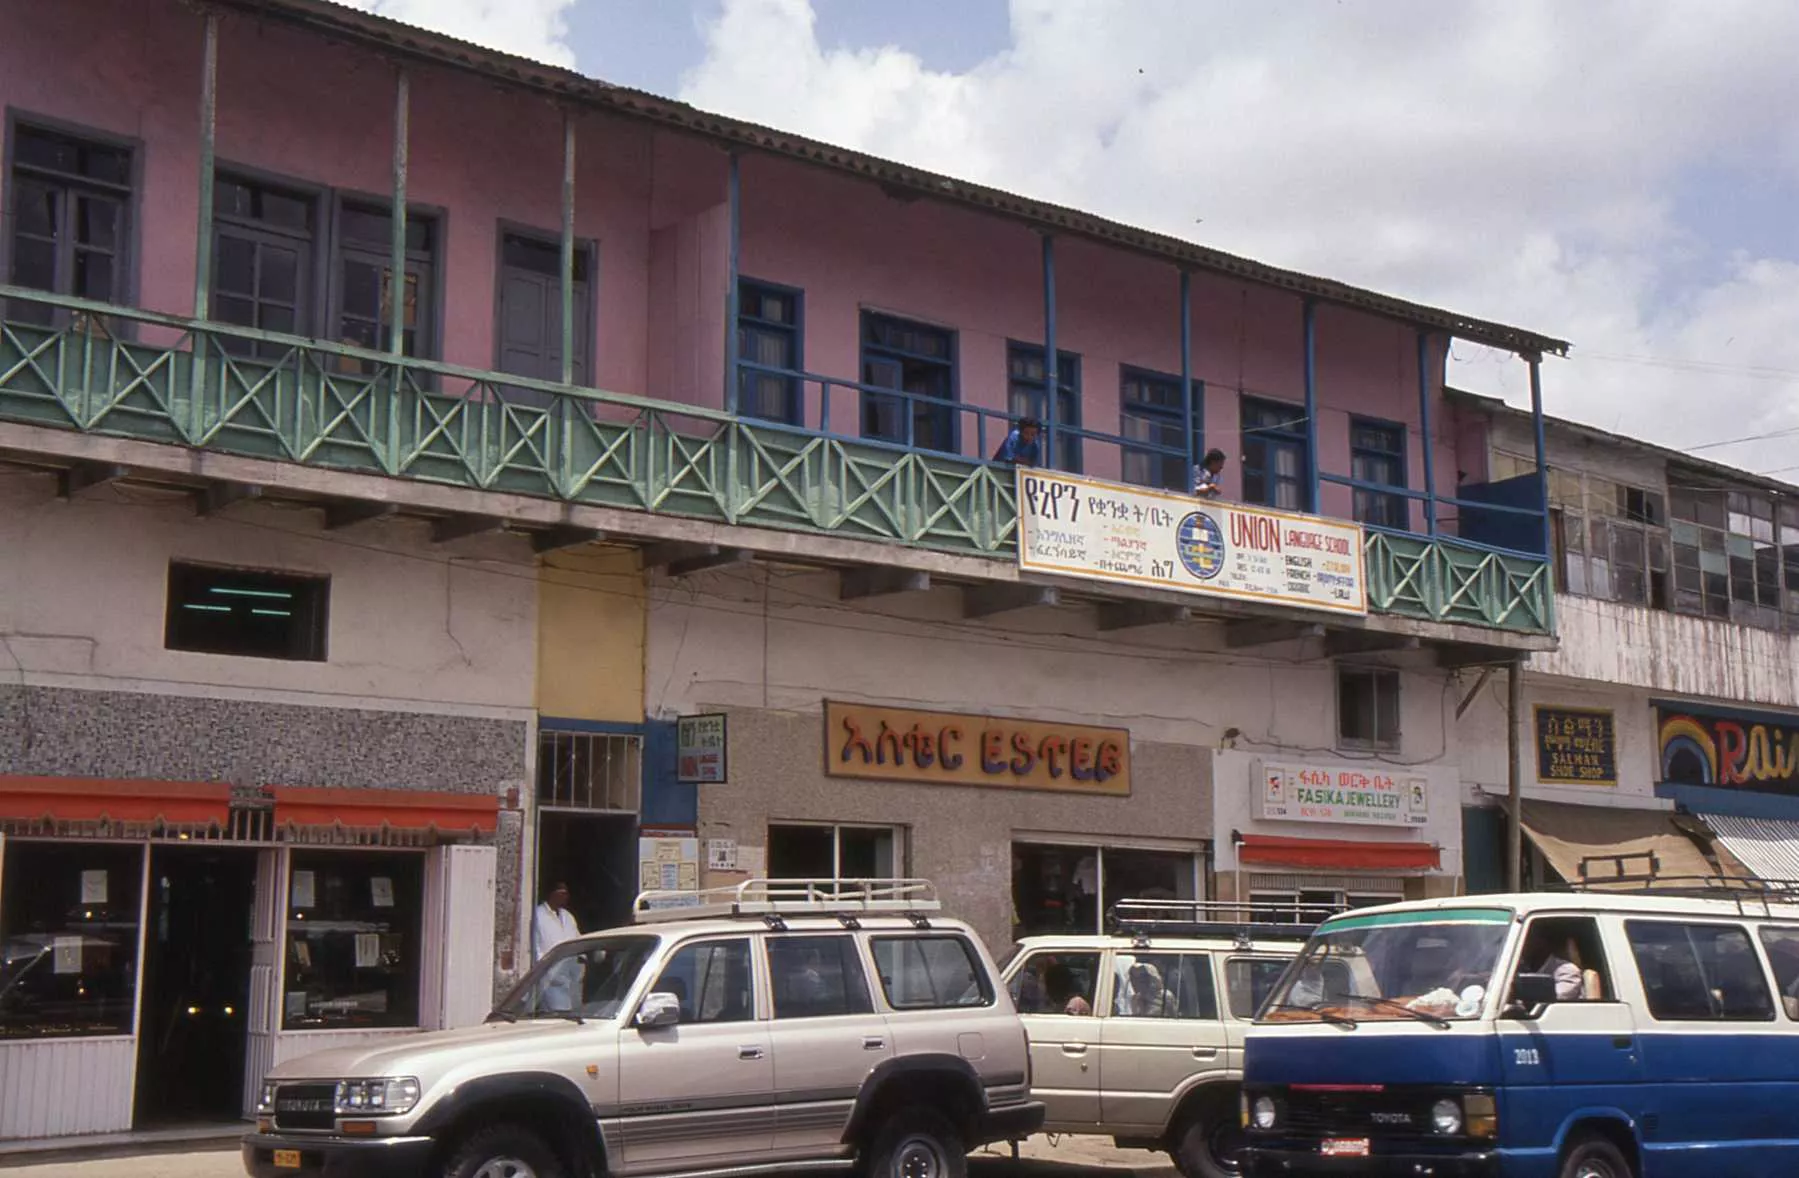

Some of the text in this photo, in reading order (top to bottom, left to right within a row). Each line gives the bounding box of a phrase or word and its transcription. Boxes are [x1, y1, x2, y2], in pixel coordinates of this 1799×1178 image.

[1025, 477, 1080, 522] ዩኒየን
[1088, 496, 1130, 521] የቋንቋ
[1230, 511, 1351, 556] UNION LANGUAGE SCHOOL
[1285, 555, 1312, 568] ENGLISH
[1286, 568, 1312, 581] FRENCH
[841, 716, 964, 770] አስቴር
[980, 730, 1123, 783] ESTER
[1551, 752, 1601, 765] SALMAN
[1550, 765, 1605, 778] SHOE SHOP
[1297, 788, 1400, 809] FASIKA JEWELLERY
[1514, 1048, 1539, 1065] 2013
[287, 1100, 320, 1112] TOYOTA
[1371, 1113, 1411, 1124] TOYOTA
